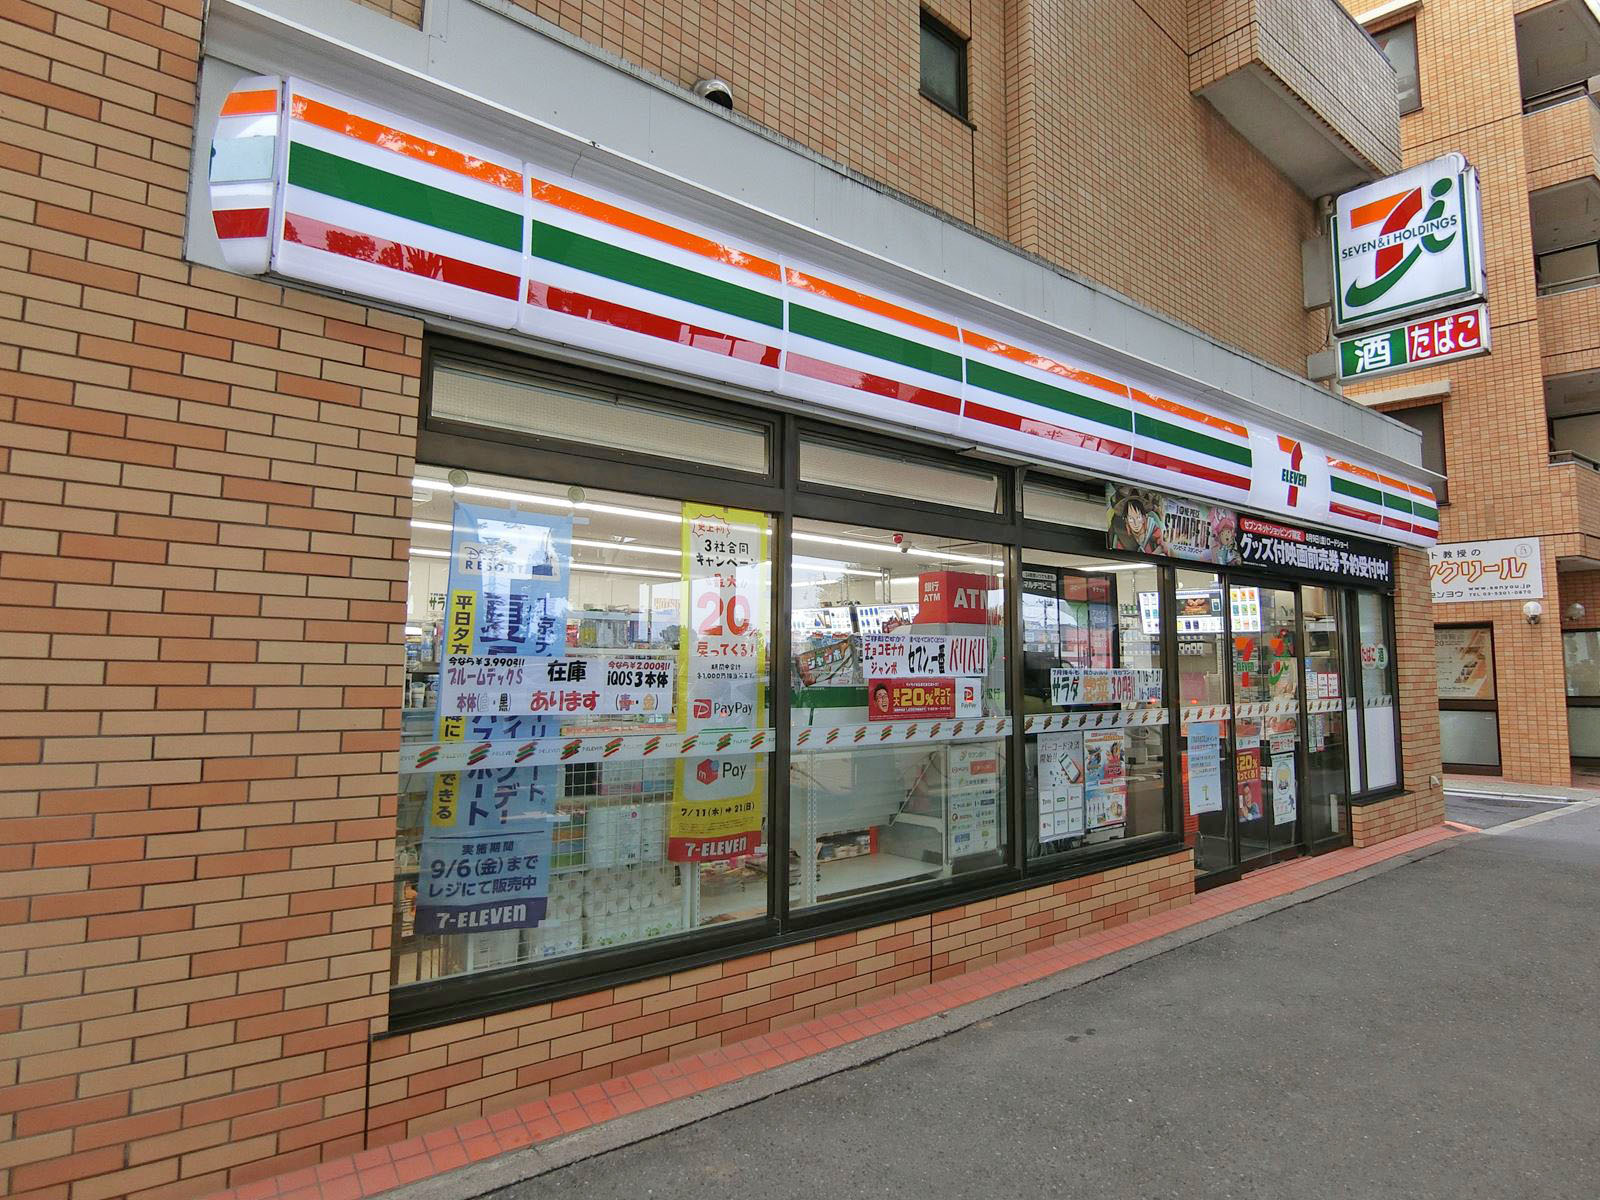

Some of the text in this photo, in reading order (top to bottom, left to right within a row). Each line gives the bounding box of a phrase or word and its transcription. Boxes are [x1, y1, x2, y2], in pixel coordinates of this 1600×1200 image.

[1393, 214, 1458, 243] HOLDINGS
[1410, 314, 1478, 361] たばこ
[1355, 333, 1392, 374] 酒
[704, 539, 749, 555] 3社合同
[1240, 532, 1340, 574] グッズ付映画前売券
[696, 552, 758, 569] キャンペーン
[923, 593, 941, 603] ATM
[696, 641, 755, 657] 戻ってくる!
[864, 642, 905, 657] チョコモナカ
[547, 660, 588, 683] 在庫
[871, 661, 898, 675] ジャンボ
[1052, 676, 1080, 703] サラダ
[530, 690, 600, 713] あります
[714, 701, 753, 717] PayPay
[461, 840, 515, 856] 実施期間
[429, 873, 537, 898] レジにて販売中
